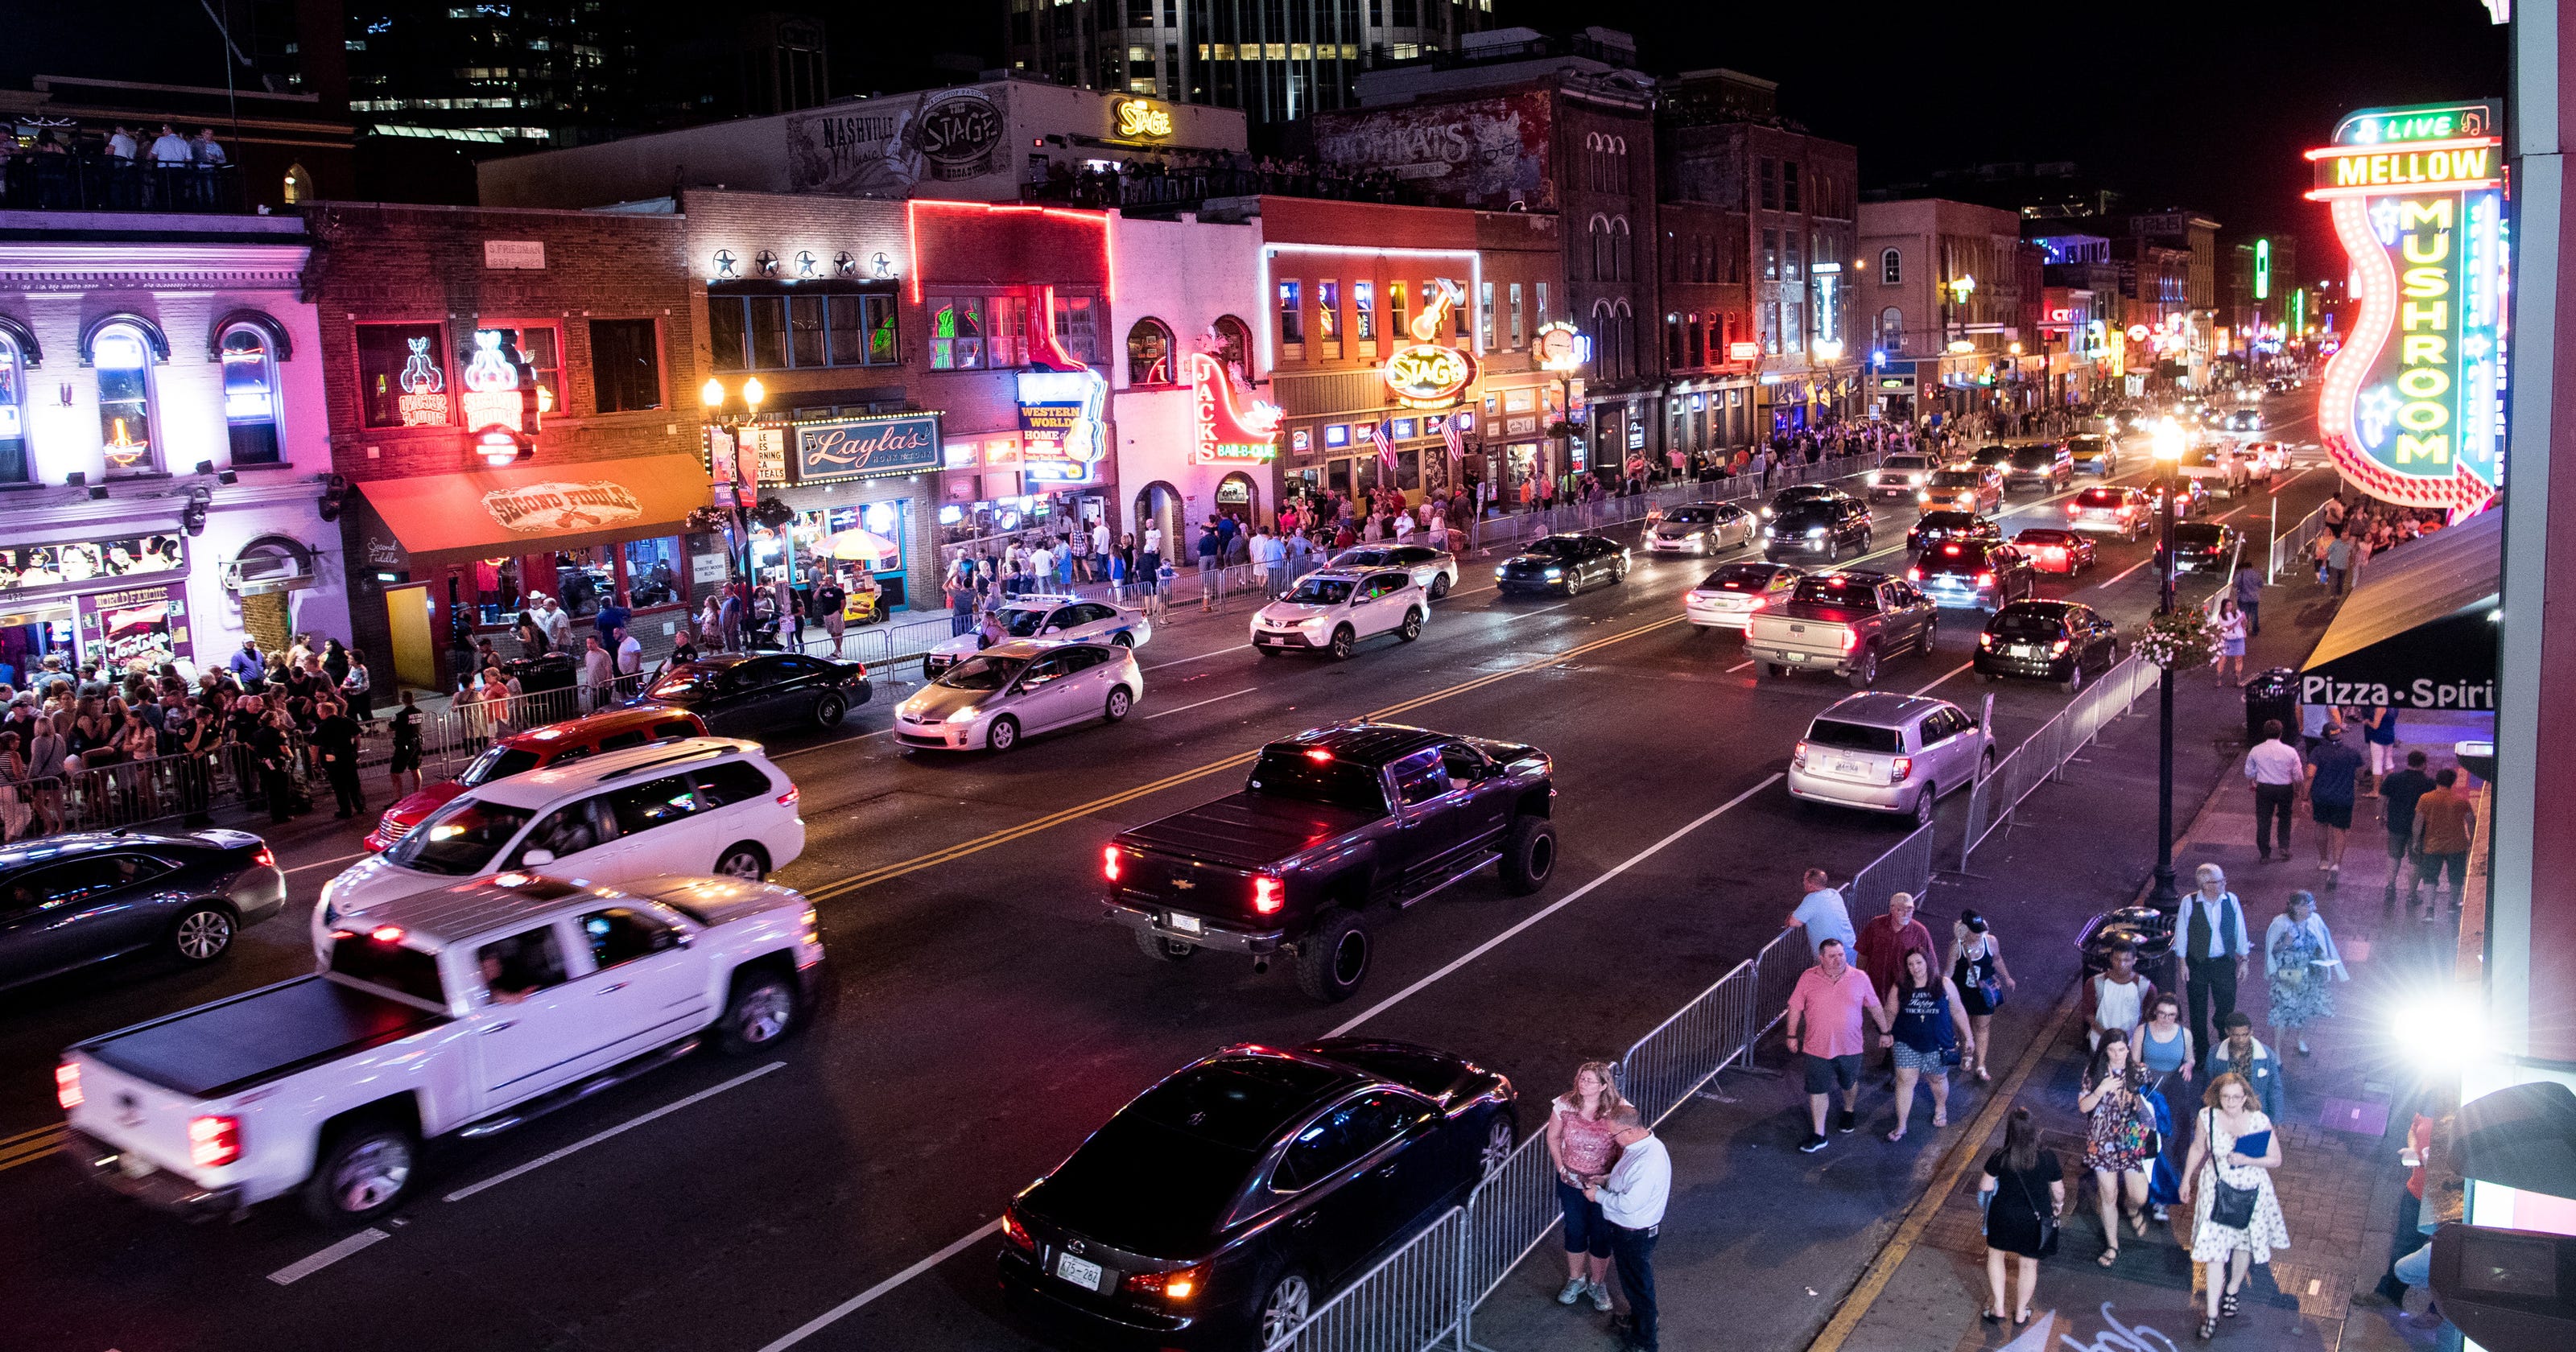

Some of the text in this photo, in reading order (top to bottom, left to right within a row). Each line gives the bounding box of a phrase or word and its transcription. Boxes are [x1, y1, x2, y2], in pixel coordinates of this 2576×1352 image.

[948, 102, 967, 114] THE
[1120, 101, 1173, 135] STAGE
[822, 117, 894, 148] NASHVILLE
[922, 111, 999, 152] STAGE
[2387, 116, 2453, 140] LIVE
[2337, 146, 2488, 186] MELLOW
[2396, 198, 2453, 464] MUSHROOM
[1022, 406, 1080, 417] WESTERN
[1030, 417, 1071, 427] WORLD
[1197, 363, 1219, 460] JACKS
[807, 425, 930, 468] Layla's
[1024, 430, 1059, 441] HOME
[758, 470, 784, 478] TEALS
[489, 487, 641, 526] SECOND FIDDLE
[367, 537, 397, 554] Second
[368, 552, 399, 564] Fiddle
[7, 592, 24, 602] 422
[94, 587, 168, 608] WORLD FAMOUS
[2302, 675, 2496, 708] Pizza Spiri
